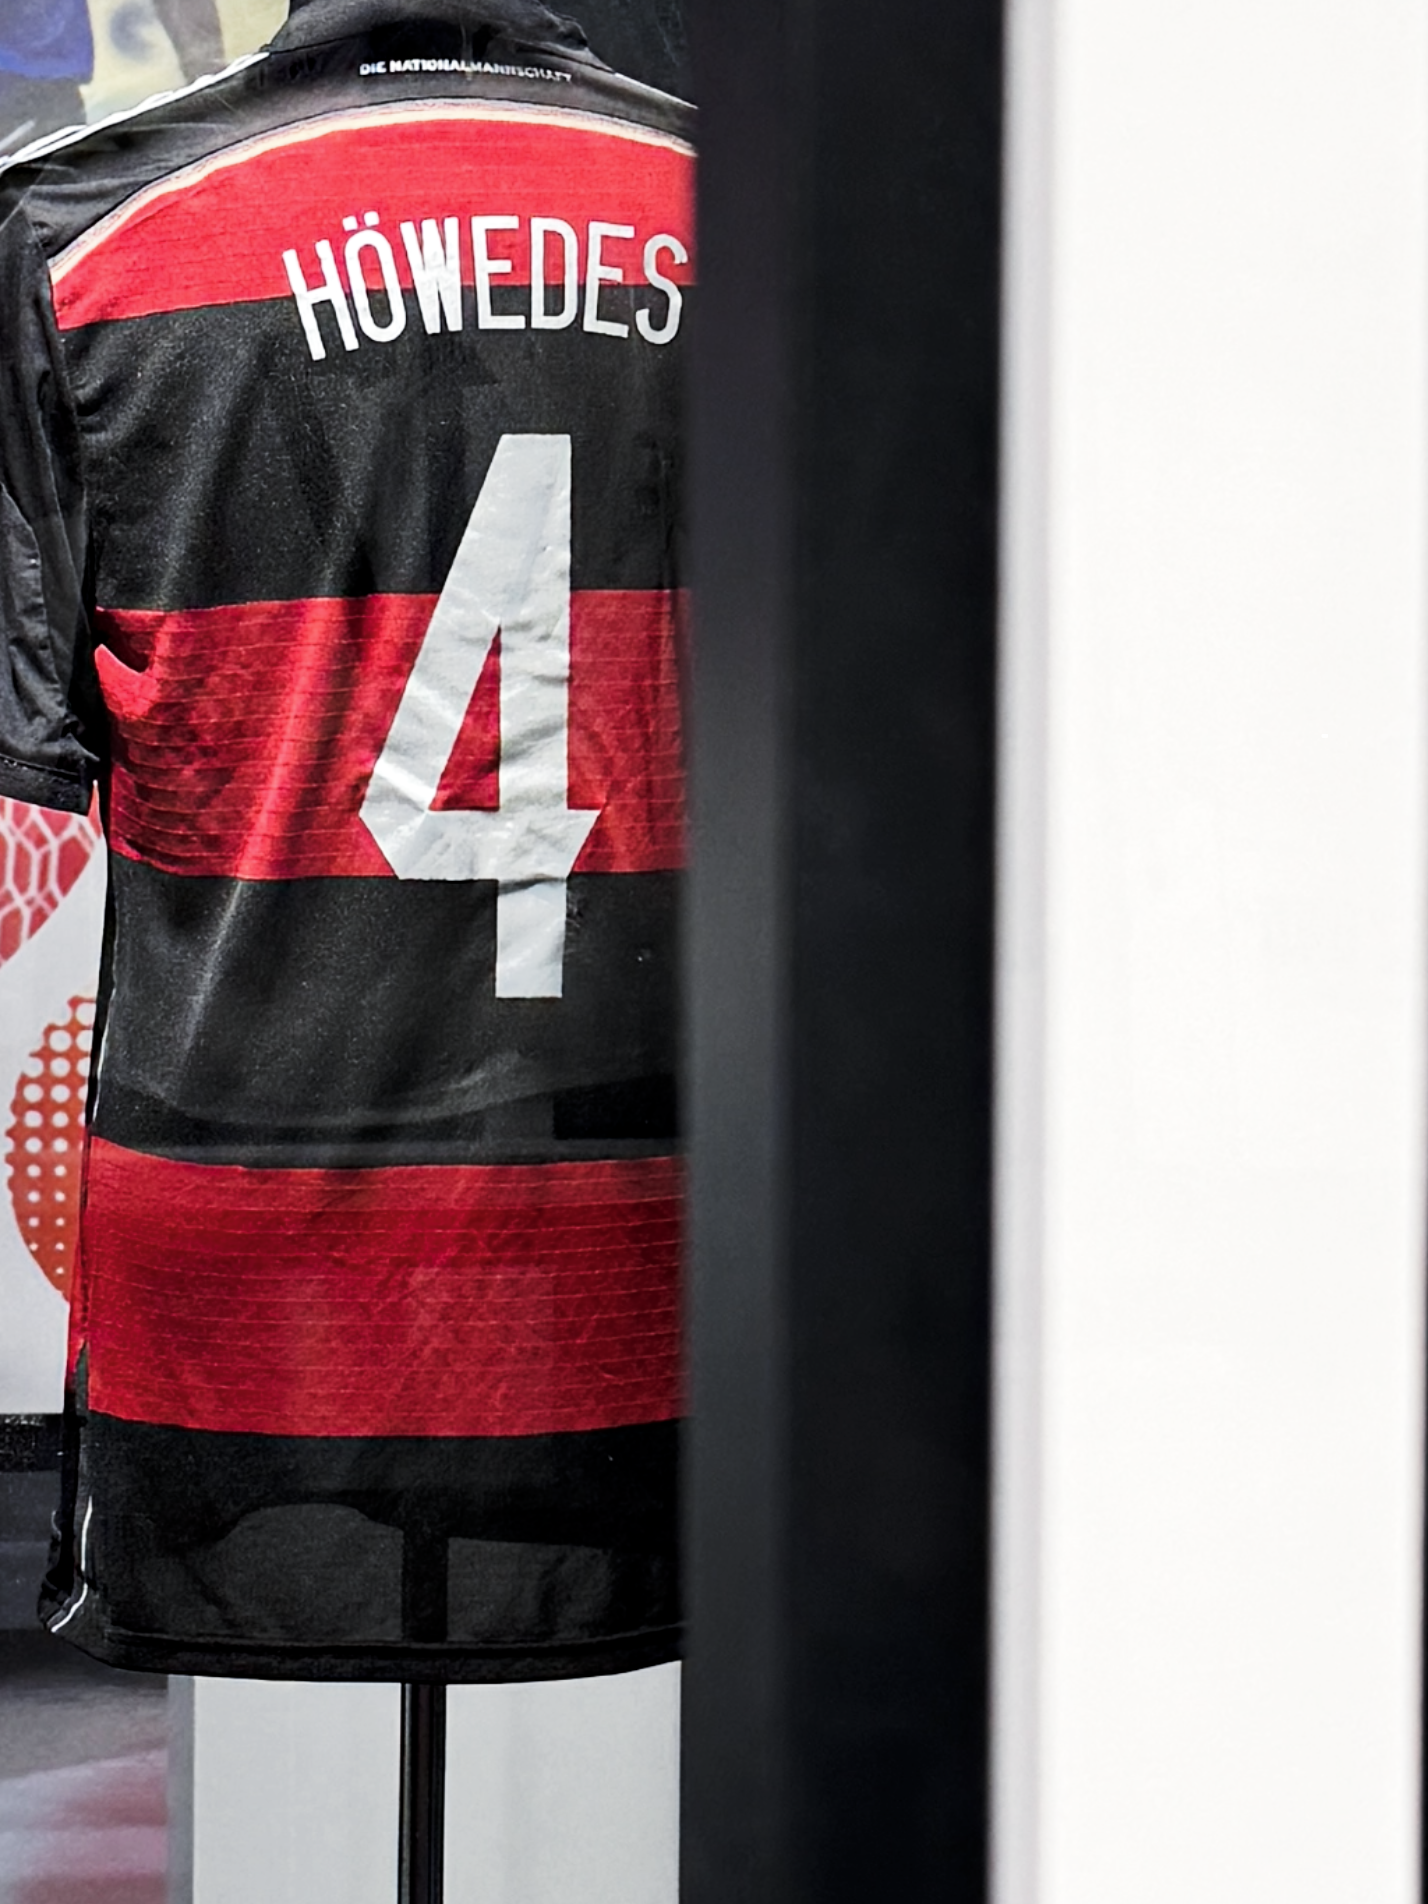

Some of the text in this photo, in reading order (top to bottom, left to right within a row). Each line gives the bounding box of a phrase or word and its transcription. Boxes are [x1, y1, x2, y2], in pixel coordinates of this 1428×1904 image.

[359, 61, 386, 75] DIE
[281, 212, 689, 362] HÖWEDES
[358, 432, 602, 999] 4
